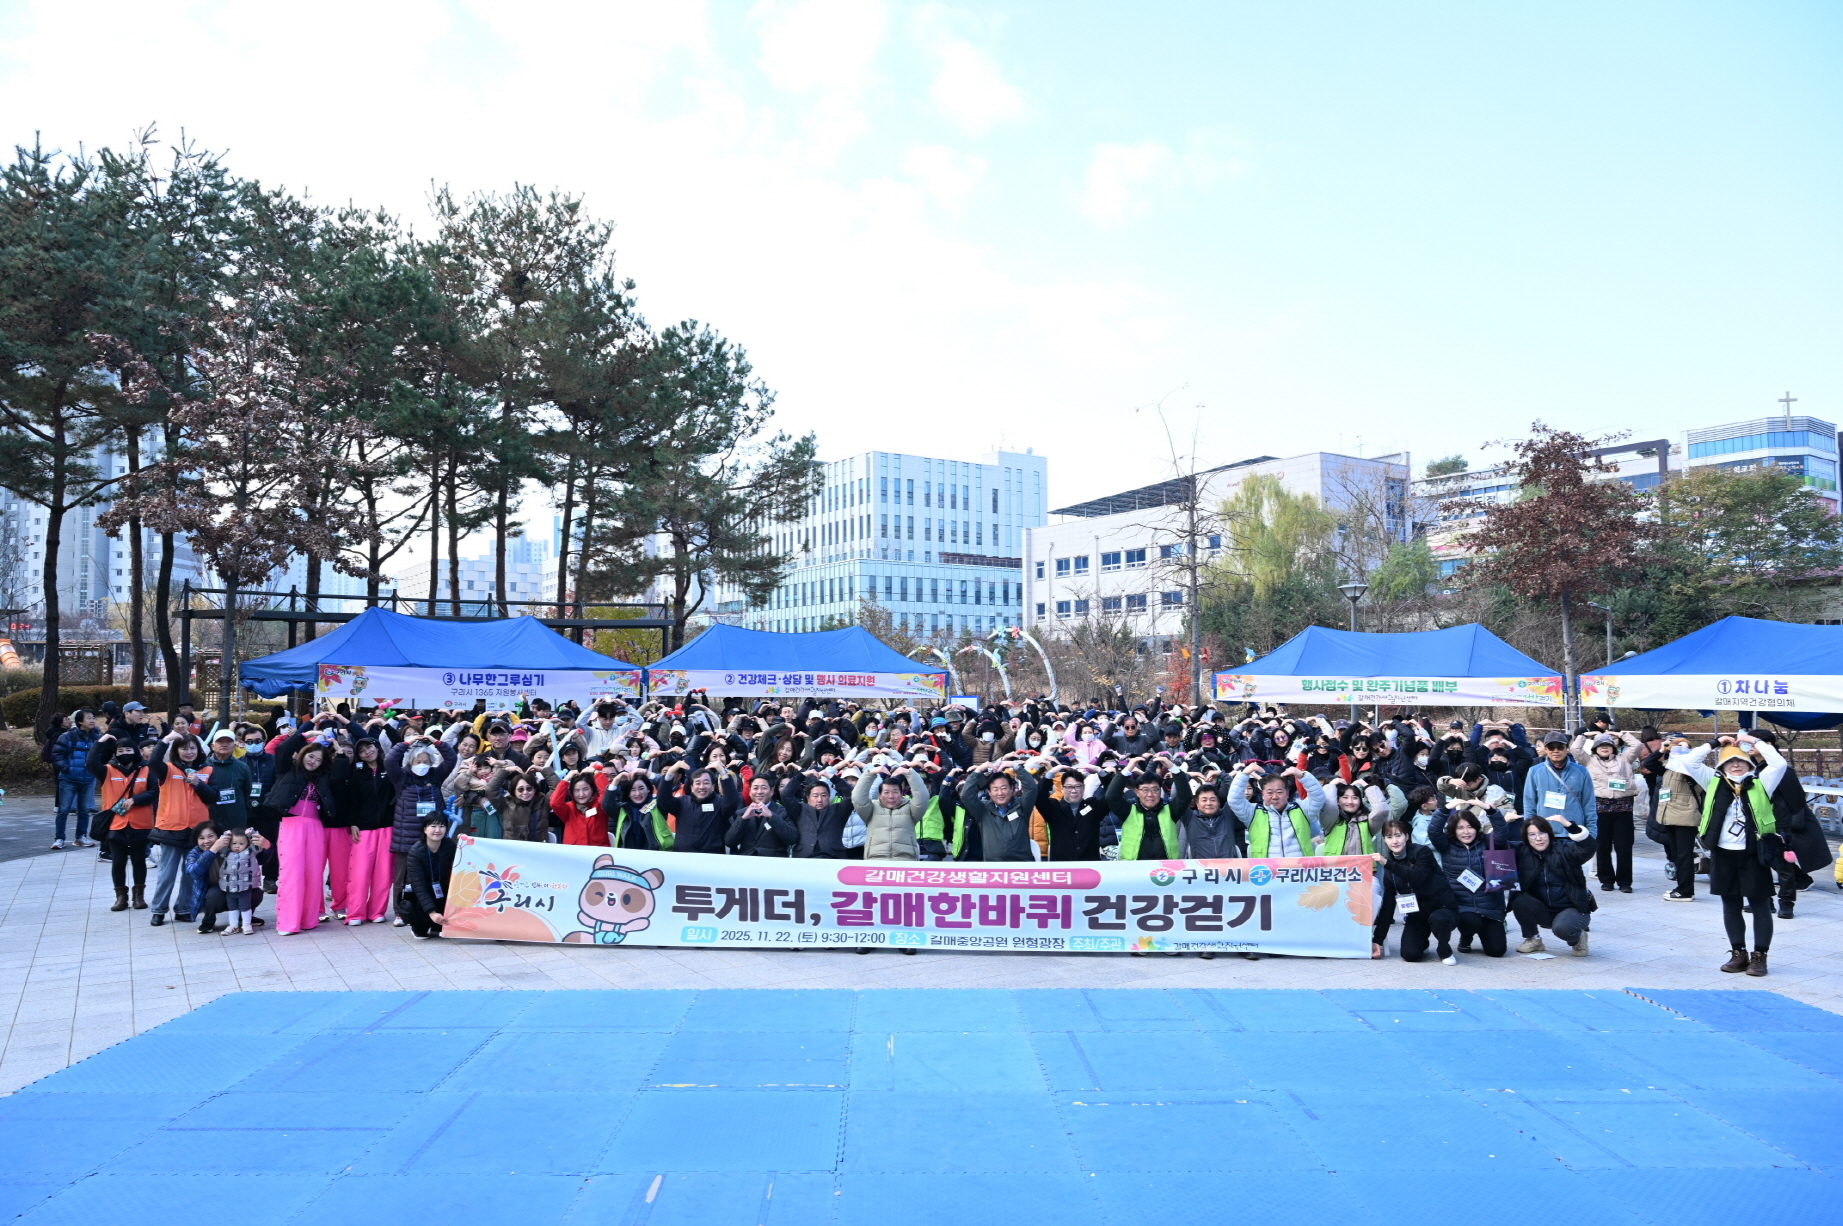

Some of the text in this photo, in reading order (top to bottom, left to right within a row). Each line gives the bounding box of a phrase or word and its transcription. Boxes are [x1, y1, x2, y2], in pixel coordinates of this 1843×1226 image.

[459, 673, 545, 686] 나무한그루심기
[805, 674, 814, 685] 및
[817, 674, 836, 686] 행사
[837, 675, 876, 687] 의료지원
[1301, 679, 1458, 693] 행사접수 및 완주기념품 배부
[450, 688, 473, 696] 구리시
[475, 688, 494, 697] 1365
[1714, 697, 1796, 708] 갈매지역건강협의체
[597, 869, 637, 882] GURI WALK
[864, 869, 1073, 886] 갈매건강생활지원센터
[1276, 868, 1362, 883] 구리시보건소
[485, 888, 555, 912] 구리시
[671, 884, 1272, 932] 투게더, 갈매한바퀴 건강걷기
[687, 928, 713, 941] 일시
[721, 930, 753, 942] 2025.
[757, 930, 771, 943] 11.
[775, 931, 794, 943] 22.
[798, 931, 818, 944] (토)
[821, 932, 886, 944] 9:30~12:00
[894, 933, 921, 946] 장소
[930, 935, 1008, 948] 갈매중앙공원
[1012, 936, 1066, 950] 원형광장
[1073, 936, 1122, 950] 주최/주관
